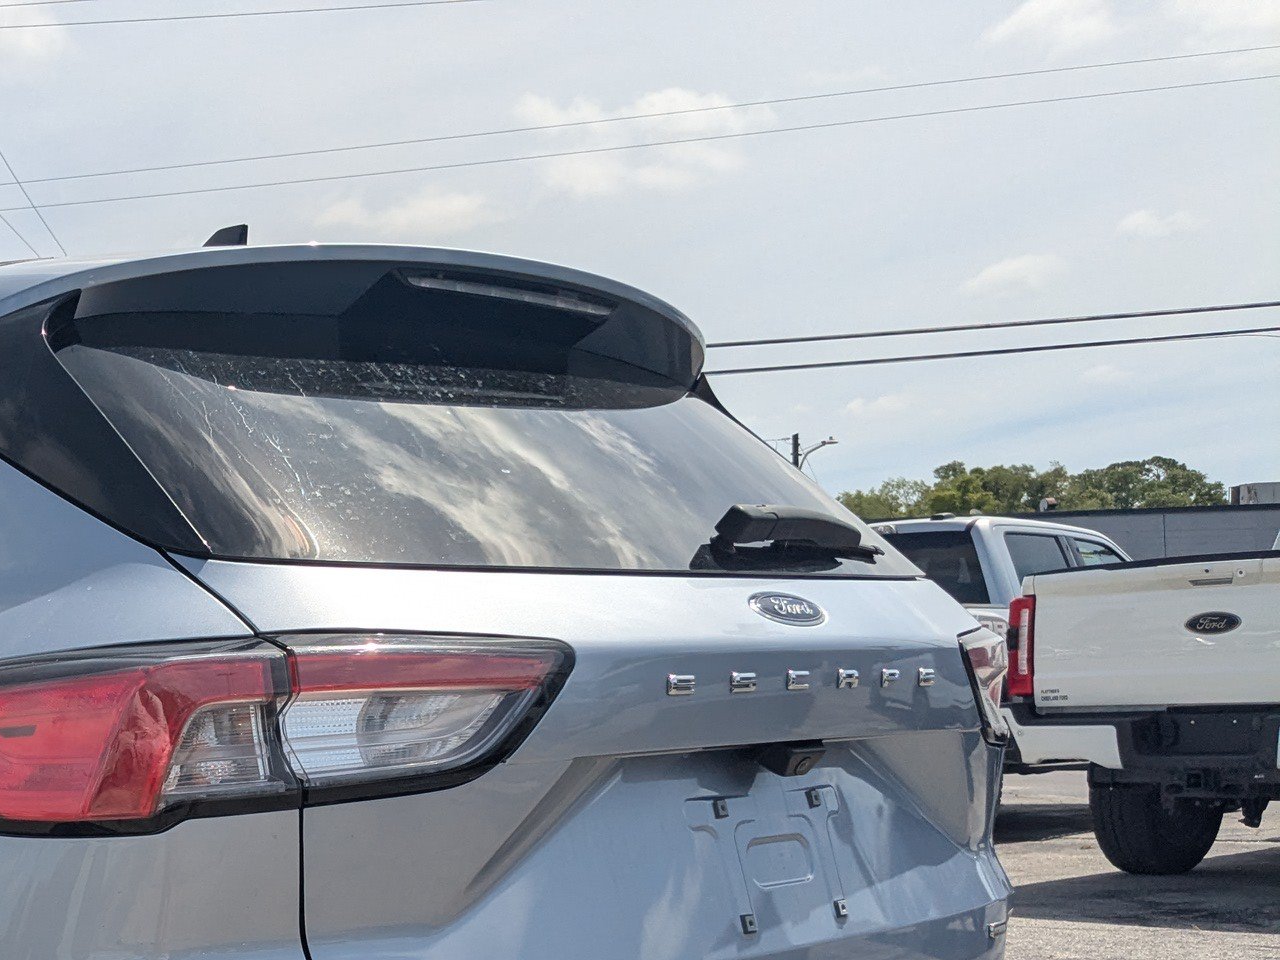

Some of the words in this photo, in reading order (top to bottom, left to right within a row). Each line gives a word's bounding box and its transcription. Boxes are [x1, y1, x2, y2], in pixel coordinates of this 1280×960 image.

[770, 596, 814, 616] Ford
[1196, 616, 1227, 630] Ford
[667, 667, 936, 696] ESCAPE
